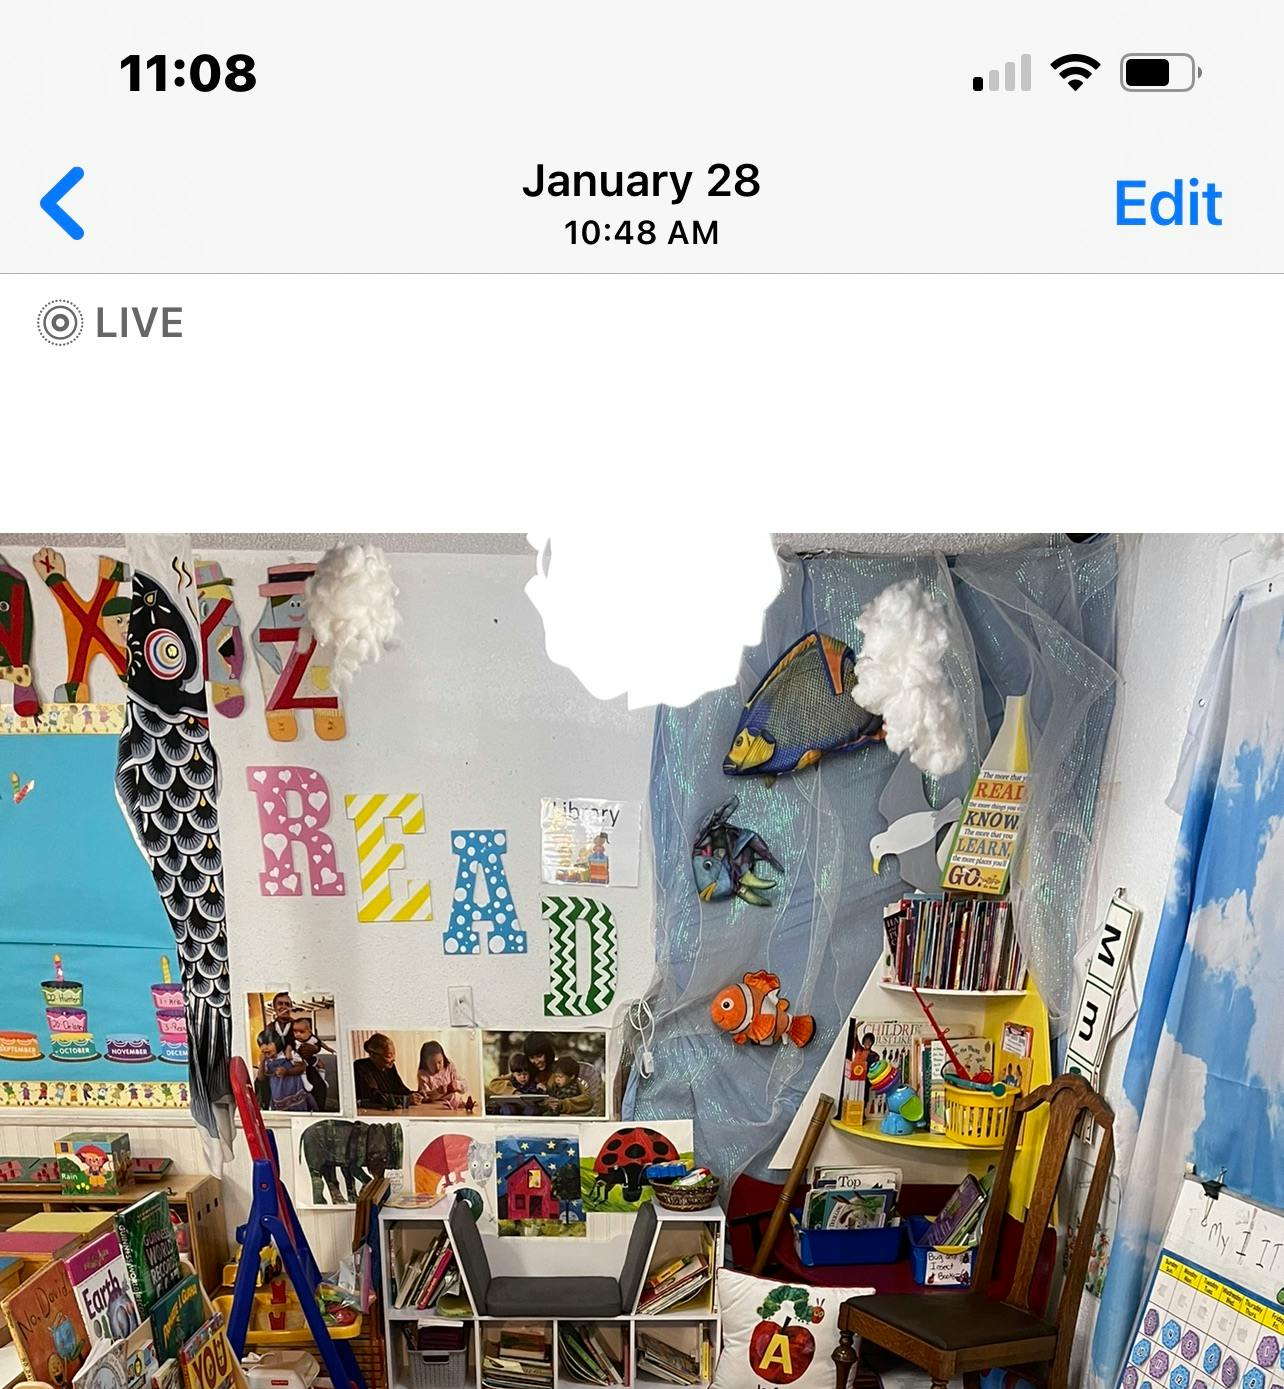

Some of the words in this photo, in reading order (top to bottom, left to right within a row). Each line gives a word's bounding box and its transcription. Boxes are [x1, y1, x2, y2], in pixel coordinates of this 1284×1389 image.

[120, 53, 257, 93] 11:08
[522, 163, 694, 206] January
[707, 162, 761, 198] 28
[1116, 177, 1223, 227] Edit
[564, 219, 657, 246] 10:48
[667, 219, 718, 245] AM
[97, 306, 183, 338] LIVE
[552, 801, 620, 827] ibry
[61, 1172, 78, 1180] Rain
[838, 1175, 862, 1188] Top
[928, 1252, 943, 1263] Bug
[82, 1268, 121, 1321] Earth
[758, 1333, 793, 1375] A
